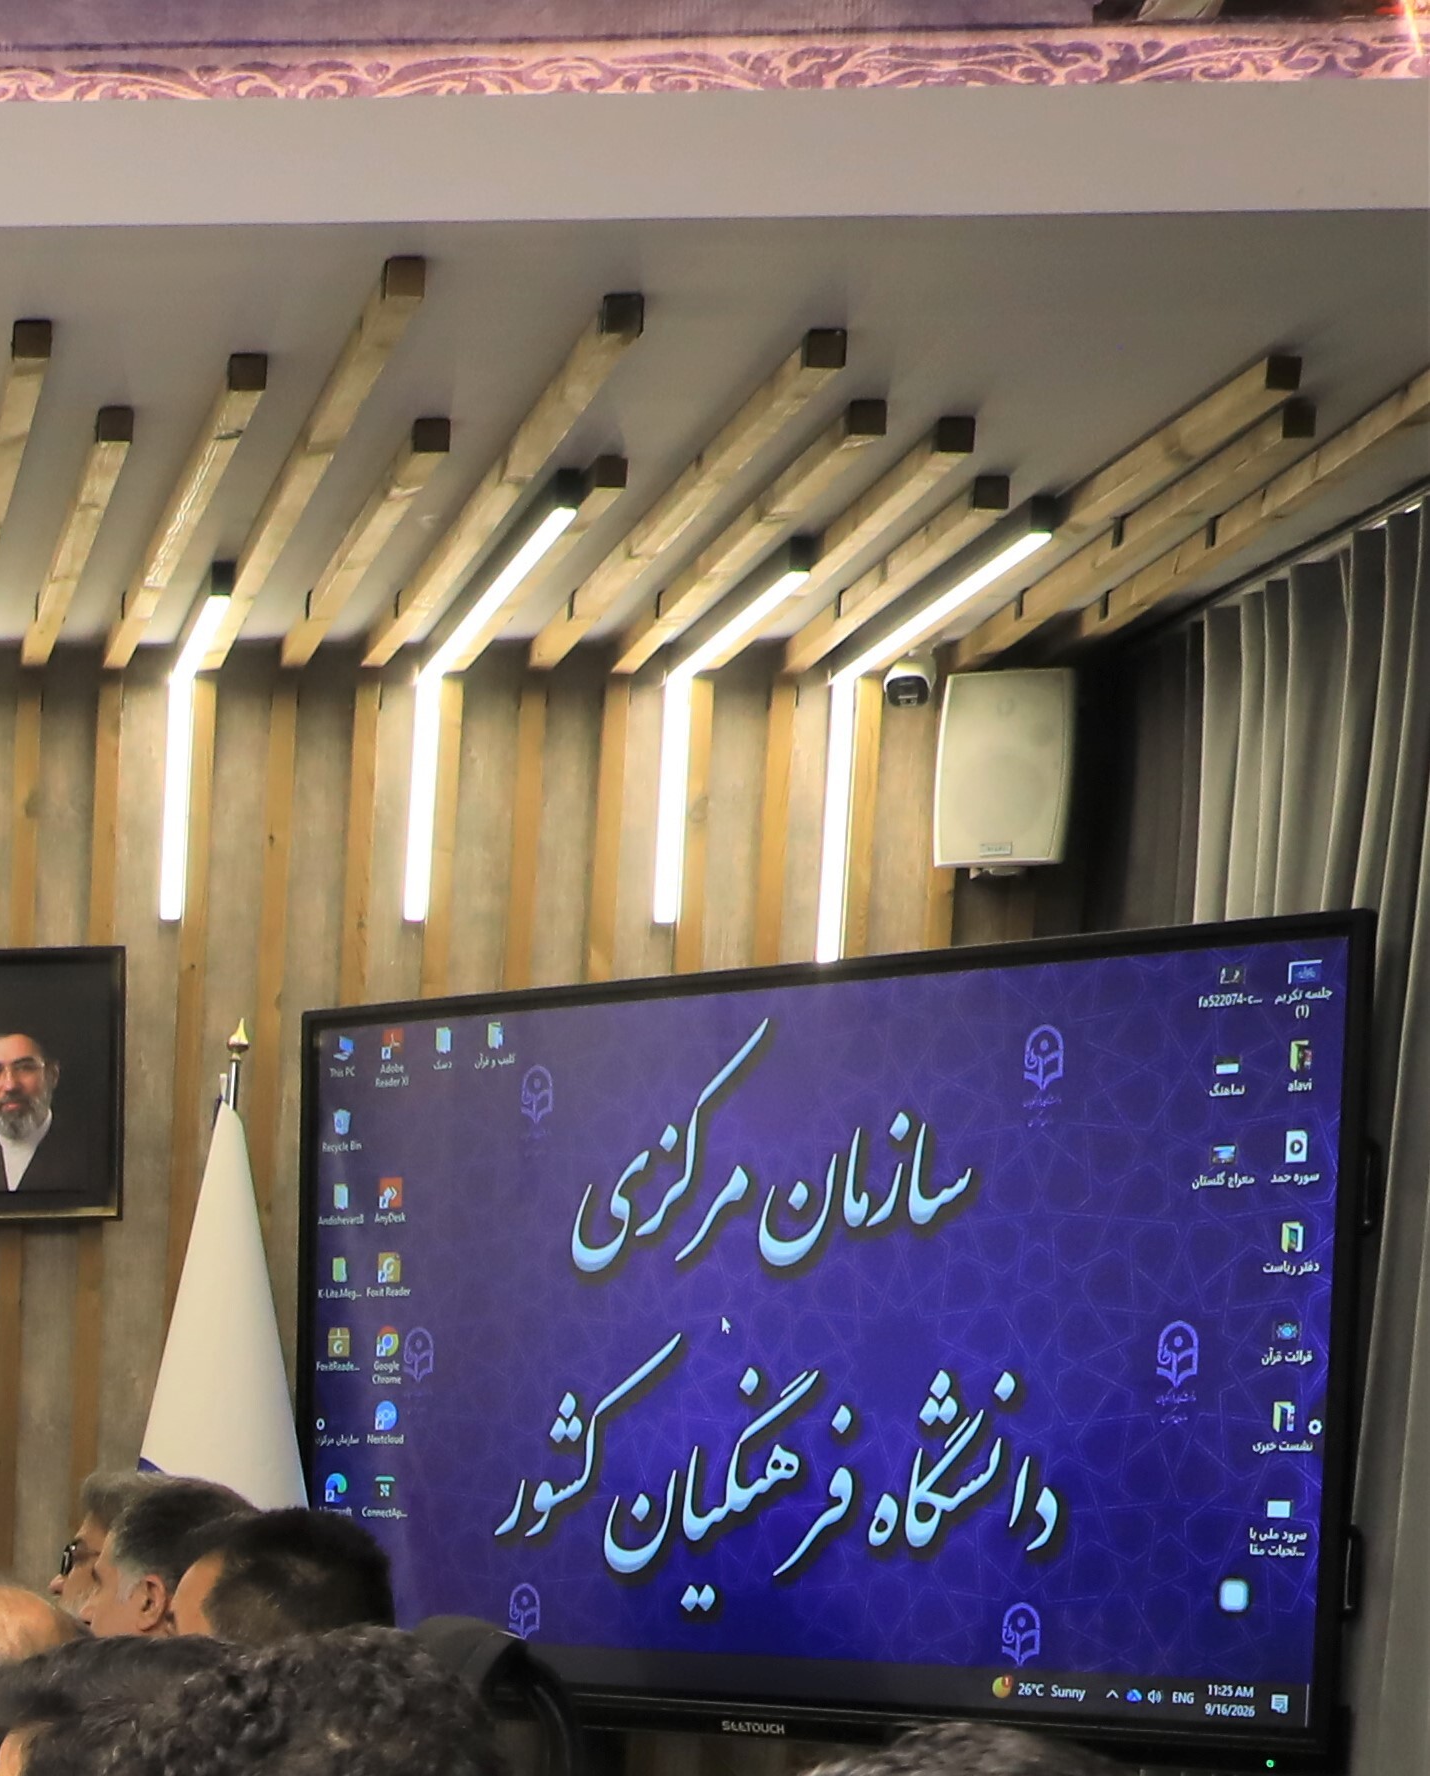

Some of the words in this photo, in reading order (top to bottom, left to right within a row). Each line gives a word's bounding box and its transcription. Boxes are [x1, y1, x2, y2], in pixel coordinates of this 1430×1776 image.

[1274, 989, 1303, 1005] تکریم
[1304, 986, 1333, 1000] جلسه
[1295, 1005, 1310, 1019] (1)
[329, 1067, 344, 1078] This
[345, 1066, 356, 1078] PC
[380, 1063, 405, 1074] Adobe
[375, 1077, 400, 1088] Reader
[1287, 1078, 1313, 1092] alavi
[322, 1142, 349, 1154] Recycle
[350, 1141, 362, 1152] Bin
[571, 1016, 770, 1273] مرکزی
[1270, 1172, 1292, 1184] حمد
[1293, 1172, 1320, 1185] سوره
[759, 1111, 972, 1267] سازمان
[374, 1212, 406, 1226] AnyDesk
[1262, 1259, 1297, 1276] ریاست
[1297, 1261, 1320, 1275] دفتر
[366, 1287, 384, 1298] Foxit
[385, 1286, 411, 1297] Reader
[1261, 1346, 1283, 1366] قرآن
[1284, 1348, 1313, 1365] قرائت
[373, 1361, 400, 1374] Google
[372, 1373, 402, 1385] Chrome
[366, 1433, 405, 1445] Nextcloud
[494, 1332, 682, 1538] کشور
[1252, 1440, 1277, 1453] خبری
[1278, 1440, 1314, 1452] نشست
[868, 1369, 1059, 1552] دانشگاه
[603, 1366, 855, 1612] فرهنگیان
[1258, 1528, 1281, 1541] ملی
[1282, 1529, 1308, 1544] سرود
[1050, 1684, 1086, 1701] Sunny
[1172, 1691, 1195, 1704] ENG
[1207, 1684, 1234, 1698] 11:25
[1234, 1685, 1255, 1699] AM
[1204, 1703, 1256, 1717] 9/16/2026
